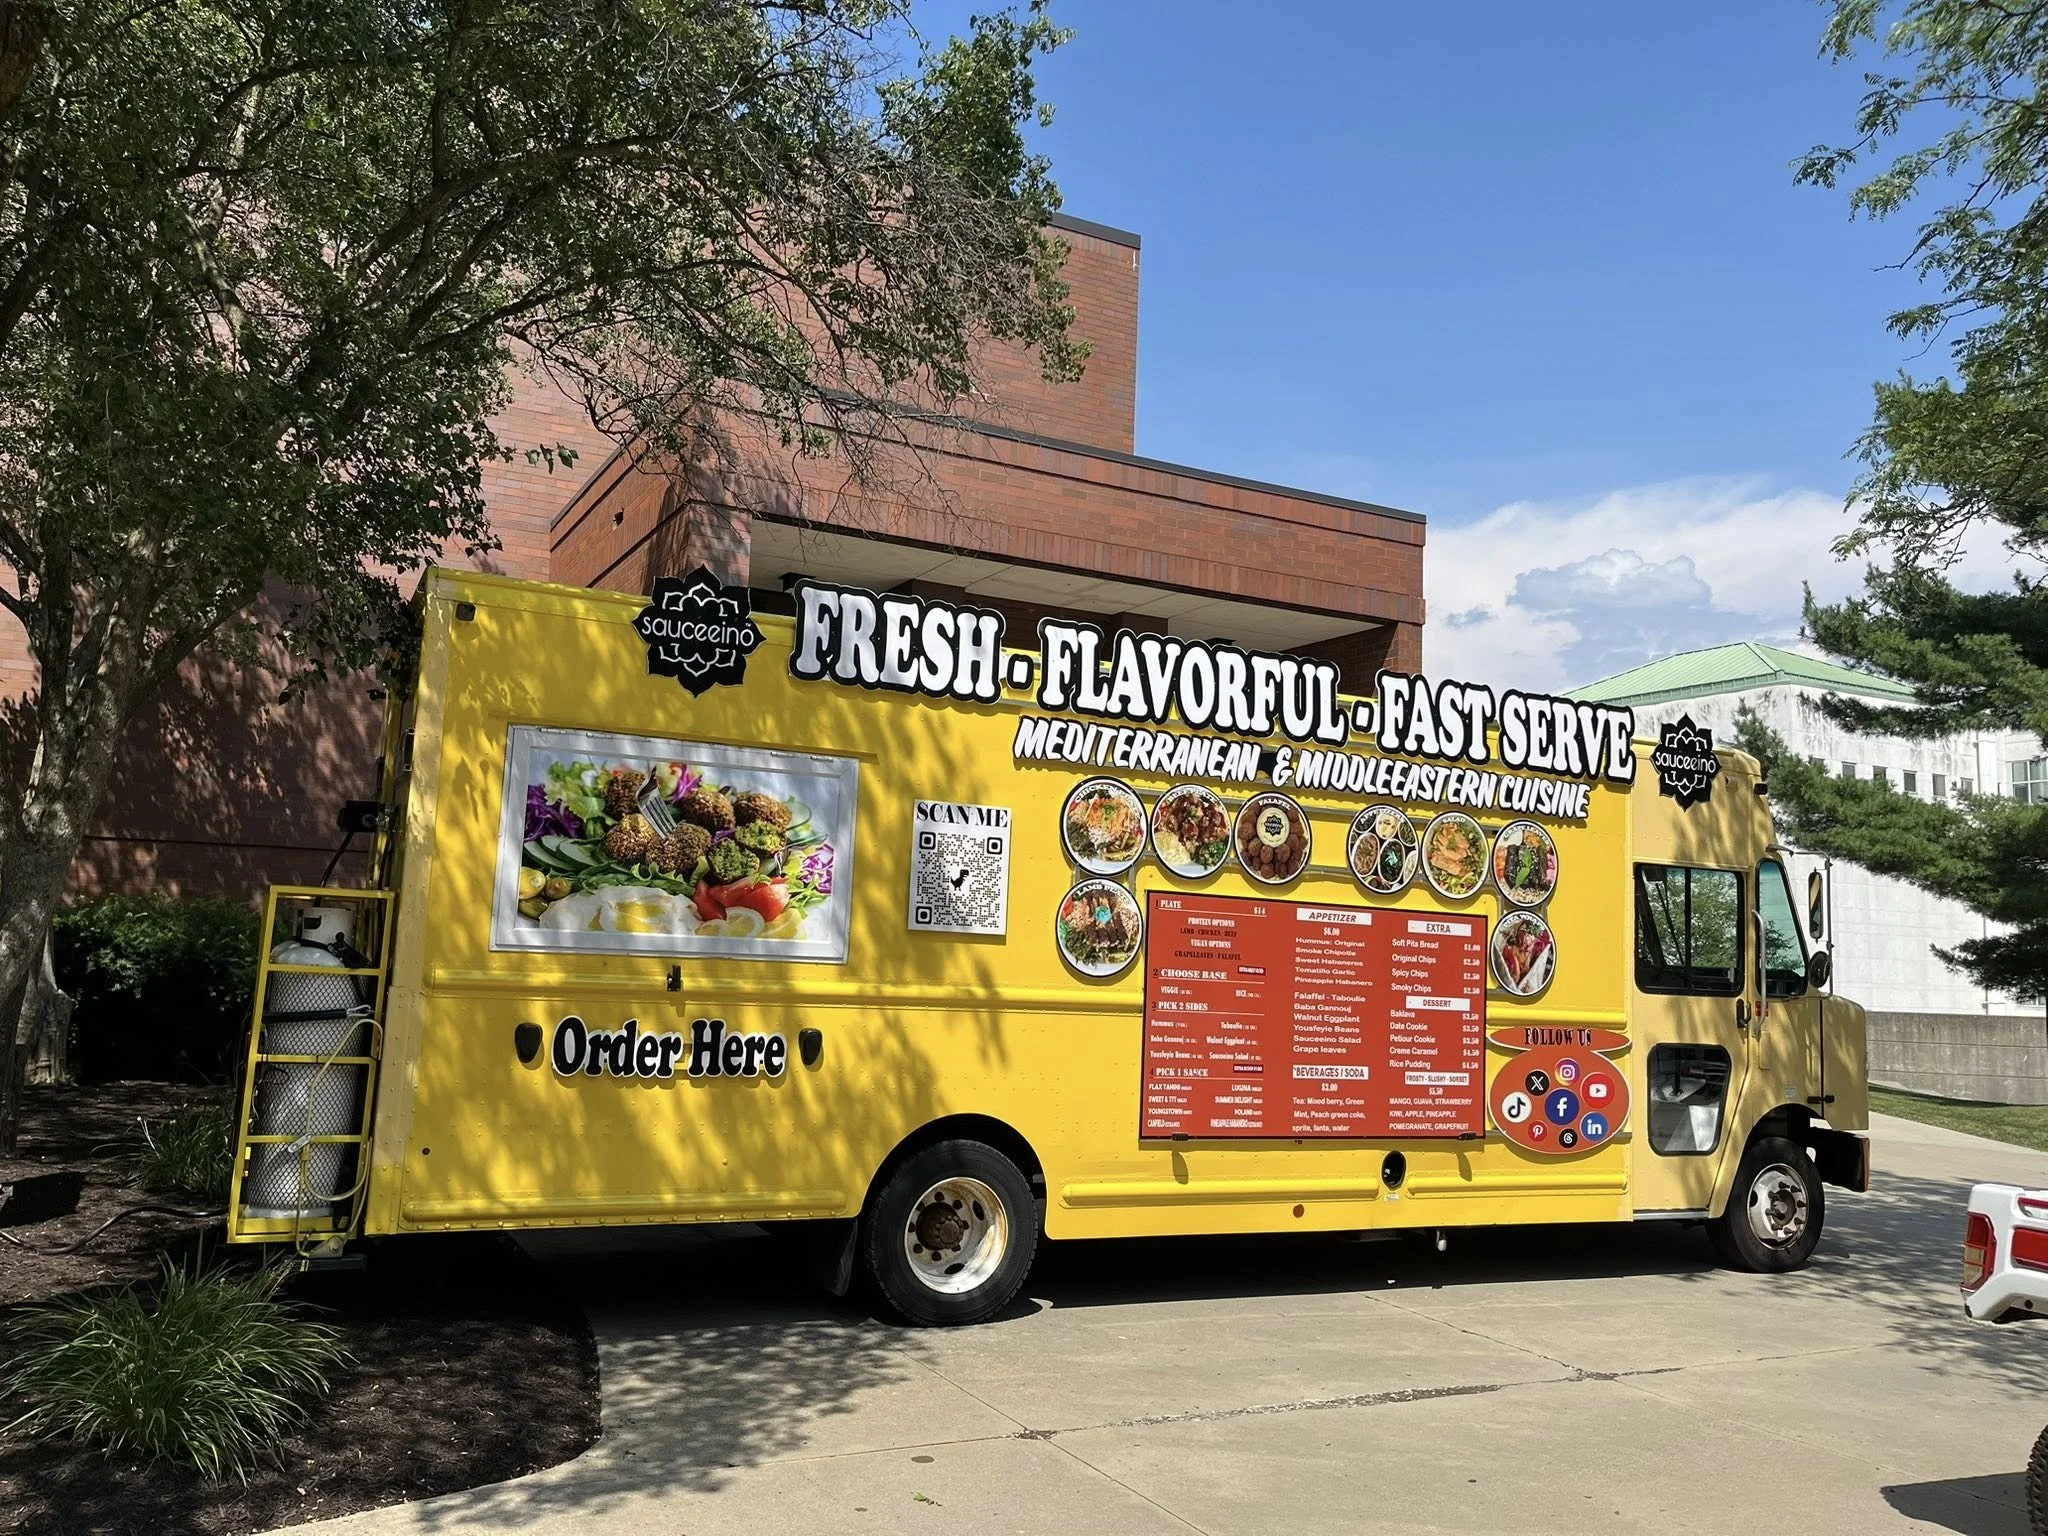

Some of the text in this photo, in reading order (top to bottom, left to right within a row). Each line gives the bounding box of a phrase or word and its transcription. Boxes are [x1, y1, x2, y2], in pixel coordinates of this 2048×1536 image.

[642, 616, 754, 647] sauceeino
[795, 583, 1634, 781] FRESH FLAVORFUL FAST SERVE
[1014, 716, 1261, 783] MEDITERRANEAN
[1272, 745, 1293, 788] &
[1499, 776, 1591, 819] CUISINE
[1655, 752, 1716, 773] sauceeino
[1258, 798, 1291, 810] FALAFEL
[916, 802, 1008, 828] SCAN ME
[1442, 816, 1466, 824] SALAD
[1075, 883, 1103, 897] LAMB
[1160, 899, 1182, 909] PLATE
[1308, 911, 1357, 923] APPETIZER
[1426, 923, 1452, 933] EXTRA
[1333, 939, 1365, 948] Original
[1391, 938, 1406, 947] Soft
[1406, 939, 1419, 948] Pita
[1419, 940, 1439, 949] Bread
[1295, 947, 1357, 957] Smoke Chipotle
[1295, 957, 1320, 965] Sweet
[1391, 953, 1418, 963] Original
[1418, 954, 1436, 965] Chips
[1160, 968, 1200, 978] CHOOSE
[1202, 970, 1228, 980] BASE
[1295, 966, 1356, 976] Tomatillo Garlic
[1391, 968, 1409, 978] Spicy
[1410, 969, 1429, 979] Chips
[1294, 976, 1373, 987] Pineapple Habanero
[1391, 982, 1412, 993] Smoky
[1413, 984, 1432, 993] Chips
[1158, 1001, 1178, 1010] PICK
[1185, 1002, 1208, 1011] SIDES
[1293, 1003, 1352, 1013] Baba Gannouj
[1422, 998, 1452, 1008] DESSERT
[1293, 1013, 1360, 1023] Walnut Eggplant
[1390, 1009, 1416, 1018] Baklava
[1334, 1026, 1360, 1034] Beans
[1390, 1021, 1405, 1030] Date
[1405, 1022, 1428, 1031] Cookie
[1338, 1036, 1362, 1044] Salad
[1413, 1035, 1436, 1044] Cookie
[1524, 1027, 1592, 1046] FOLLOW US
[553, 1016, 786, 1078] Order Here
[1293, 1045, 1347, 1054] Grape leaves
[1389, 1046, 1411, 1055] Creme
[1411, 1047, 1439, 1056] Caramel
[1389, 1059, 1404, 1068] Rice
[1404, 1060, 1431, 1070] Pudding
[1156, 1067, 1176, 1076] PICK
[1183, 1068, 1209, 1077] SAUCE
[1344, 1068, 1365, 1078] SODA
[1427, 1075, 1446, 1083] SLUSHY
[1306, 1097, 1326, 1105] Mixed
[1344, 1097, 1365, 1106] Green
[1389, 1097, 1413, 1106] MANGO,
[1435, 1098, 1473, 1106] STRAWBERRY
[1310, 1110, 1330, 1118] Peach
[1330, 1111, 1349, 1120] green
[1425, 1110, 1457, 1118] PINEAPPLE
[1434, 1123, 1470, 1131] GRAPEFRUIT
